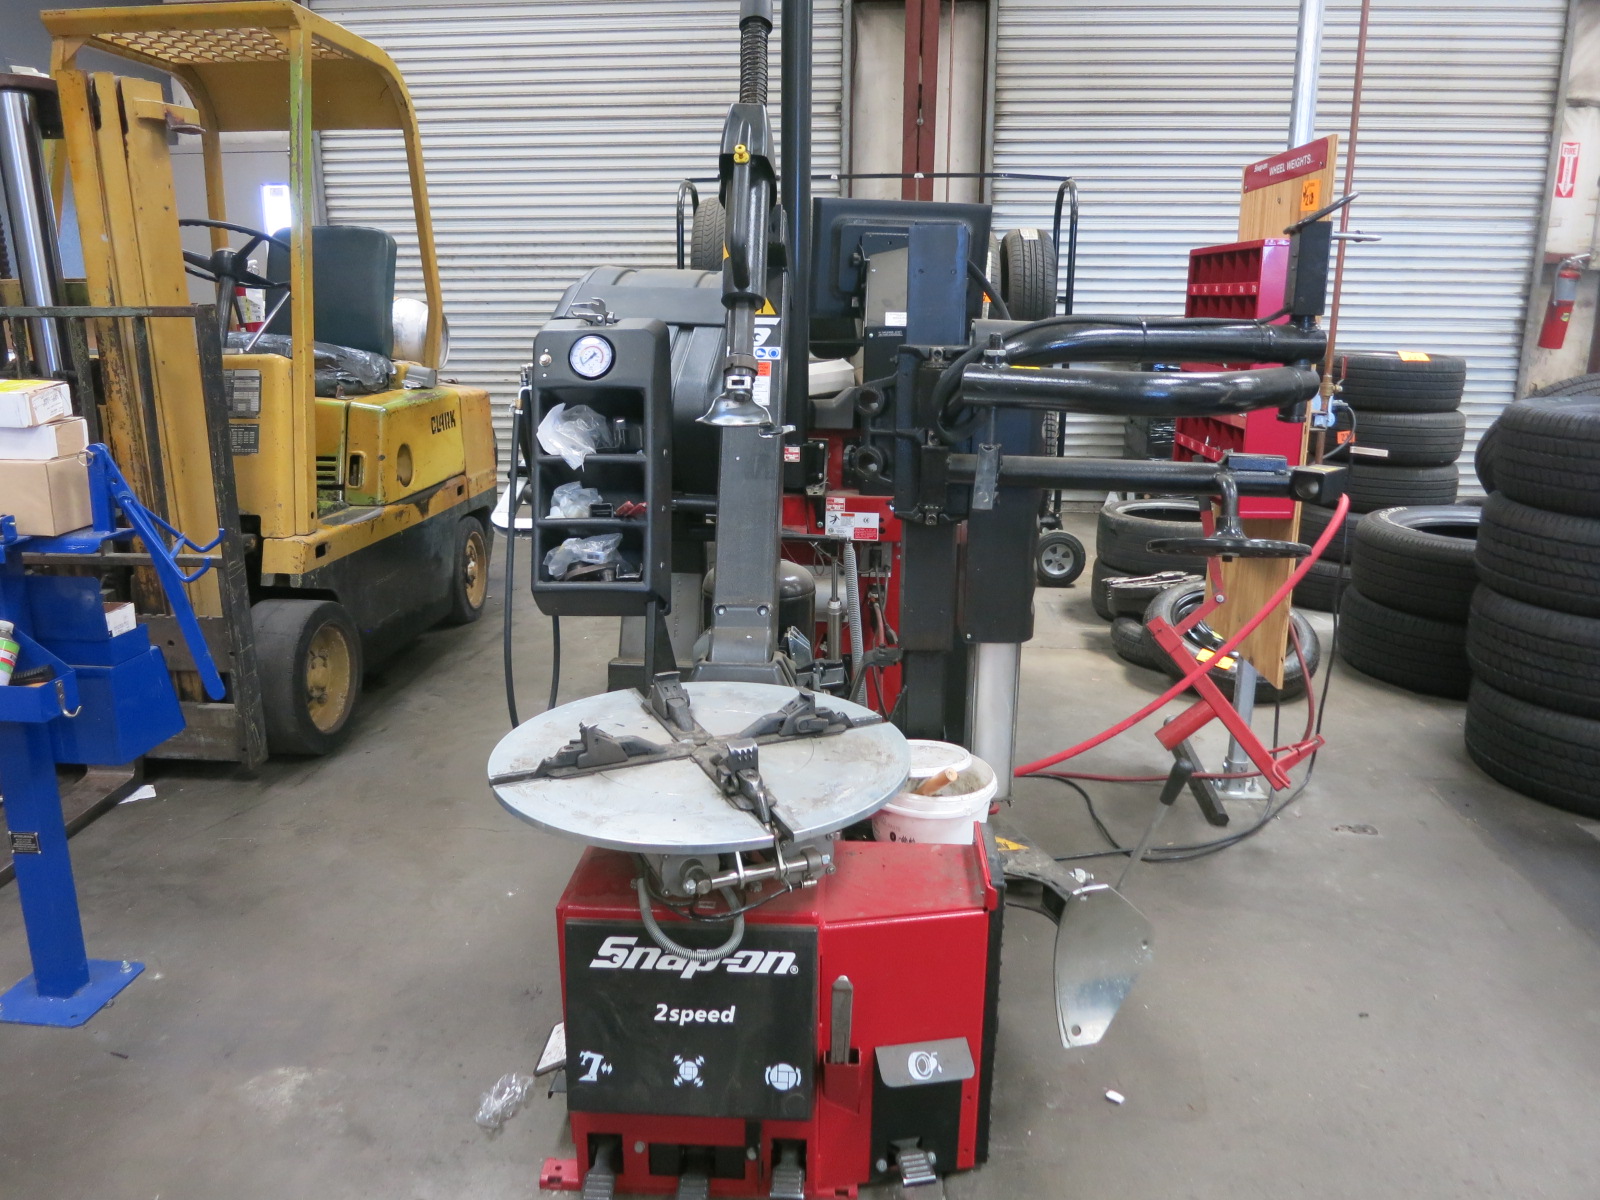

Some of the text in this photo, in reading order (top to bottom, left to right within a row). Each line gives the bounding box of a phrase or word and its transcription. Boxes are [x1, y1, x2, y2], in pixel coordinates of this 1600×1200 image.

[1563, 147, 1577, 155] FIRE
[1269, 163, 1286, 176] WHEEL
[1286, 153, 1312, 171] WEIGHTS
[431, 410, 456, 434] CLARK
[589, 936, 797, 979] Snap-on
[653, 1003, 736, 1026] 2speed
